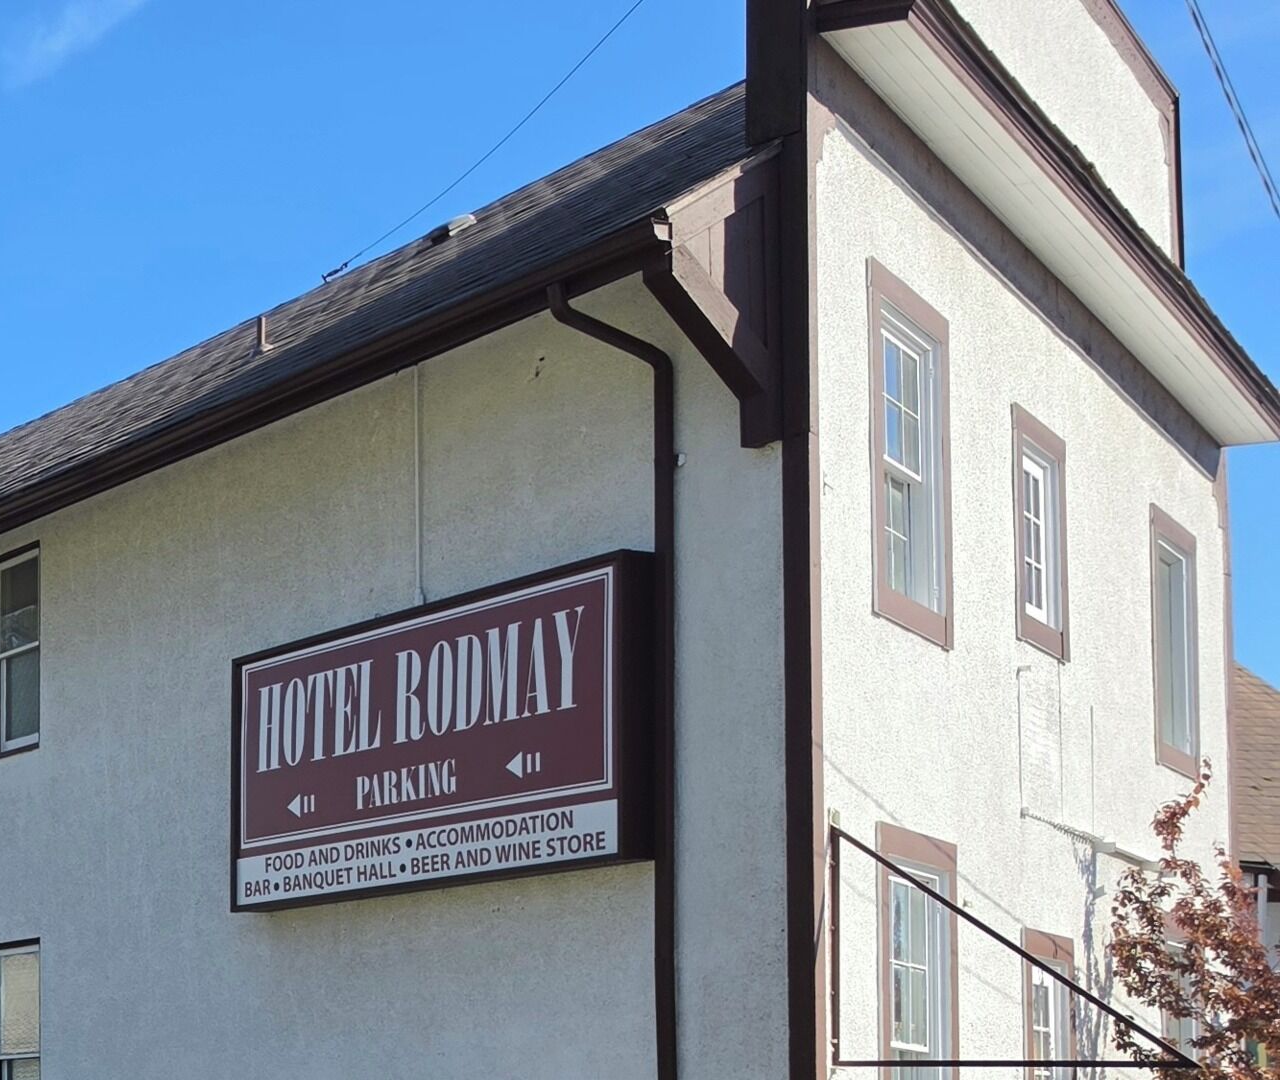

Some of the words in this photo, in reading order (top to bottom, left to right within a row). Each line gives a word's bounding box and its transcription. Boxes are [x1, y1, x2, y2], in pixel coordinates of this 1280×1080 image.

[256, 659, 382, 774] HOTEL
[393, 605, 585, 745] RODMAY
[355, 758, 458, 811] PARKING
[244, 879, 271, 898] BAR
[283, 867, 353, 892] BANQUET
[357, 861, 397, 882] HALL
[411, 853, 451, 875] BEER
[454, 848, 491, 869] AND
[495, 841, 542, 864] WINE
[546, 831, 606, 857] STORE
[264, 852, 305, 873] FOOD
[308, 846, 341, 868] AND
[344, 837, 401, 862] DRINKS
[415, 810, 574, 851] ACCOMMODATION
